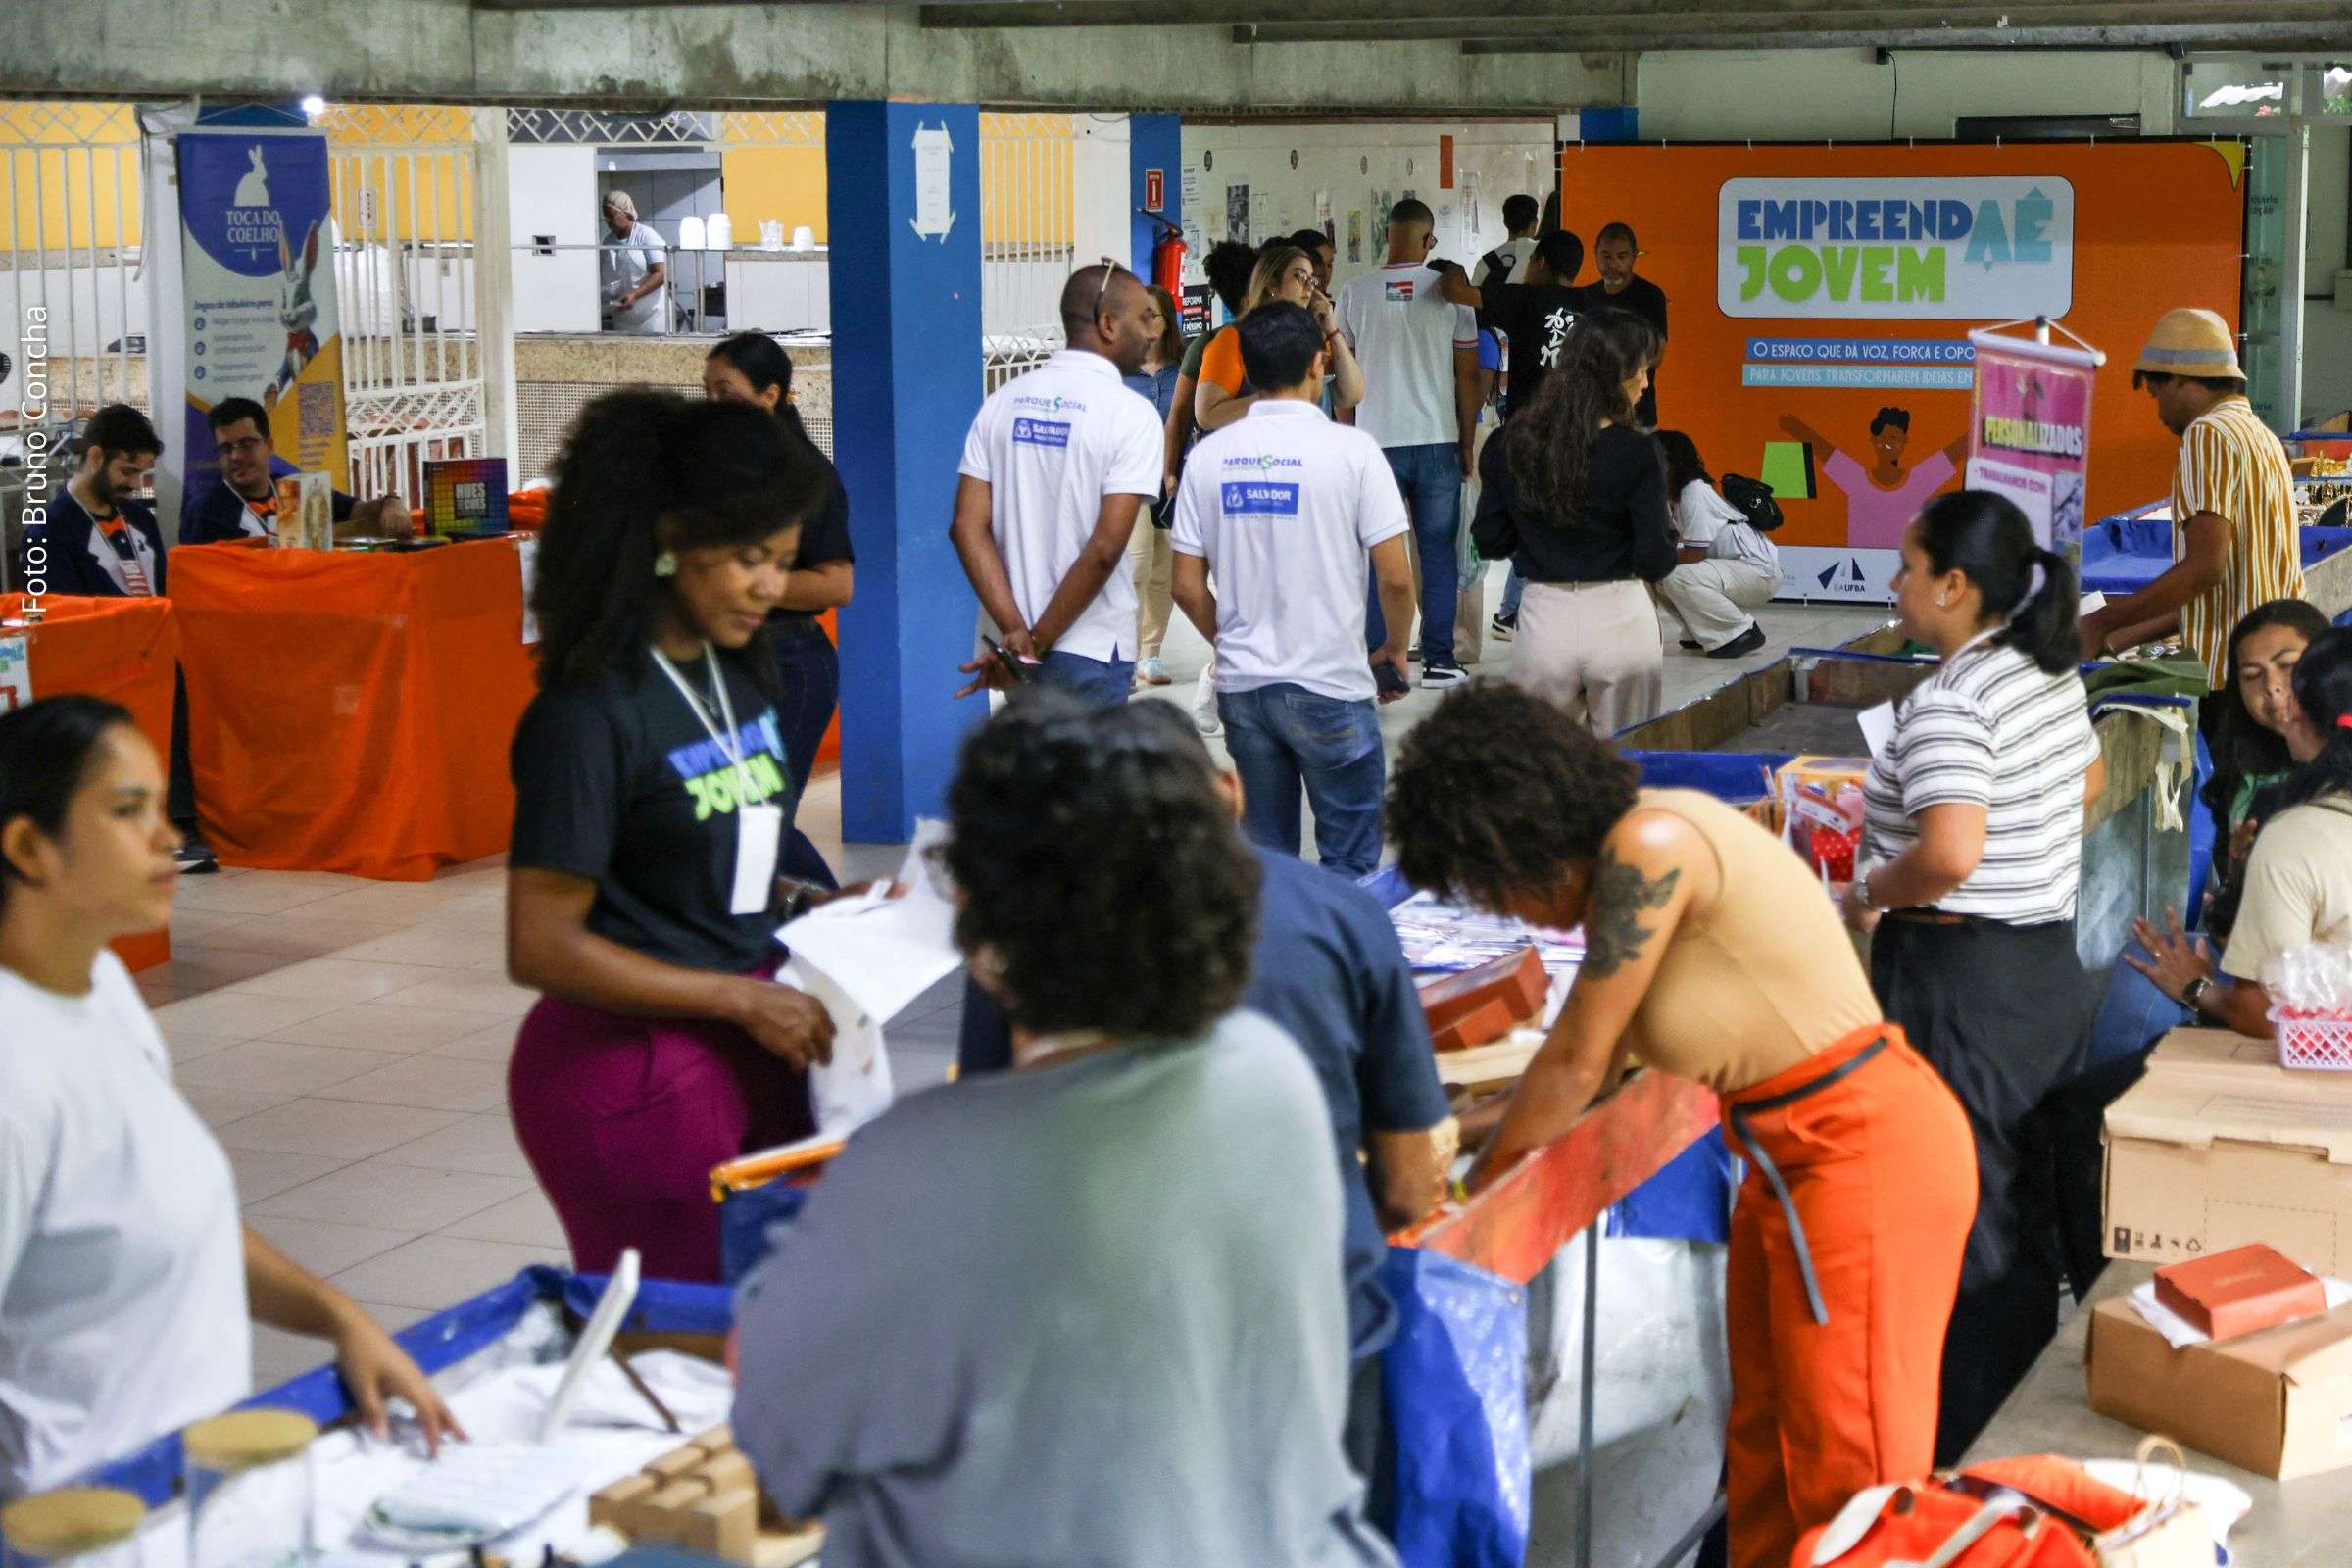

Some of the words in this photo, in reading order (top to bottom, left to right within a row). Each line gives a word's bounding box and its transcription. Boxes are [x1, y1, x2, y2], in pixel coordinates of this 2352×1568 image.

[226, 210, 262, 226] TOCA
[263, 210, 281, 225] DO
[226, 227, 279, 243] COELHO
[1737, 245, 1946, 302] JOVEM
[1753, 341, 1768, 357] O
[1817, 344, 1842, 359] QUE
[1935, 346, 1941, 360] E
[1749, 368, 1776, 381] PARA
[1780, 368, 1821, 382] JOVENS
[1826, 368, 1919, 383] TRANSFORMAREM
[1922, 370, 1954, 384] IDEIAS
[1984, 416, 2082, 457] PERSONALIZADOS
[1246, 488, 1292, 501] SALVADOR
